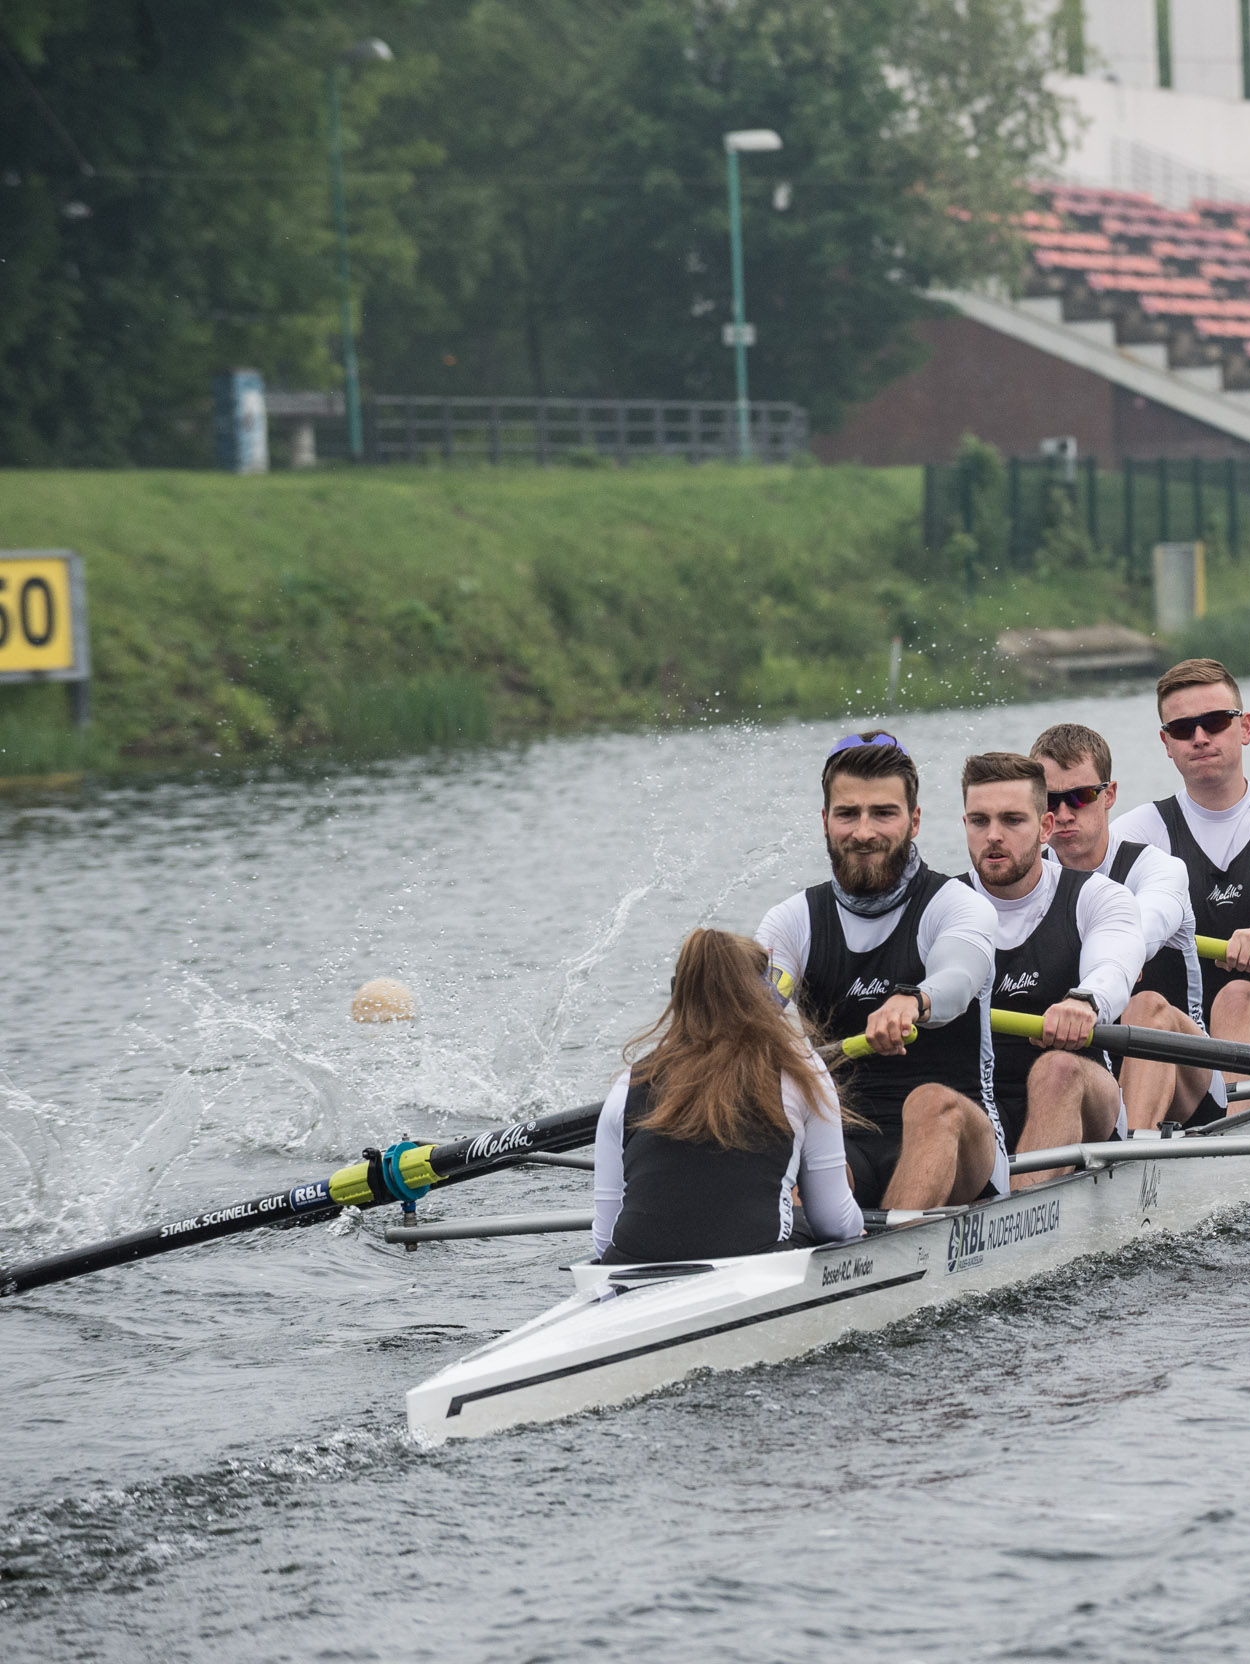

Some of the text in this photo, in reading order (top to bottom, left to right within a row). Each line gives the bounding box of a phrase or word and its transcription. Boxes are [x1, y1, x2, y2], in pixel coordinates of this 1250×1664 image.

[0, 576, 55, 648] 0
[160, 1216, 202, 1239] STARK.
[202, 1203, 258, 1227] SCHNELL.
[258, 1195, 287, 1212] GUT.
[294, 1183, 327, 1203] RBL
[961, 1199, 1060, 1258] RBL RUDER-BUNDESLIGA
[853, 1256, 874, 1278] Minden
